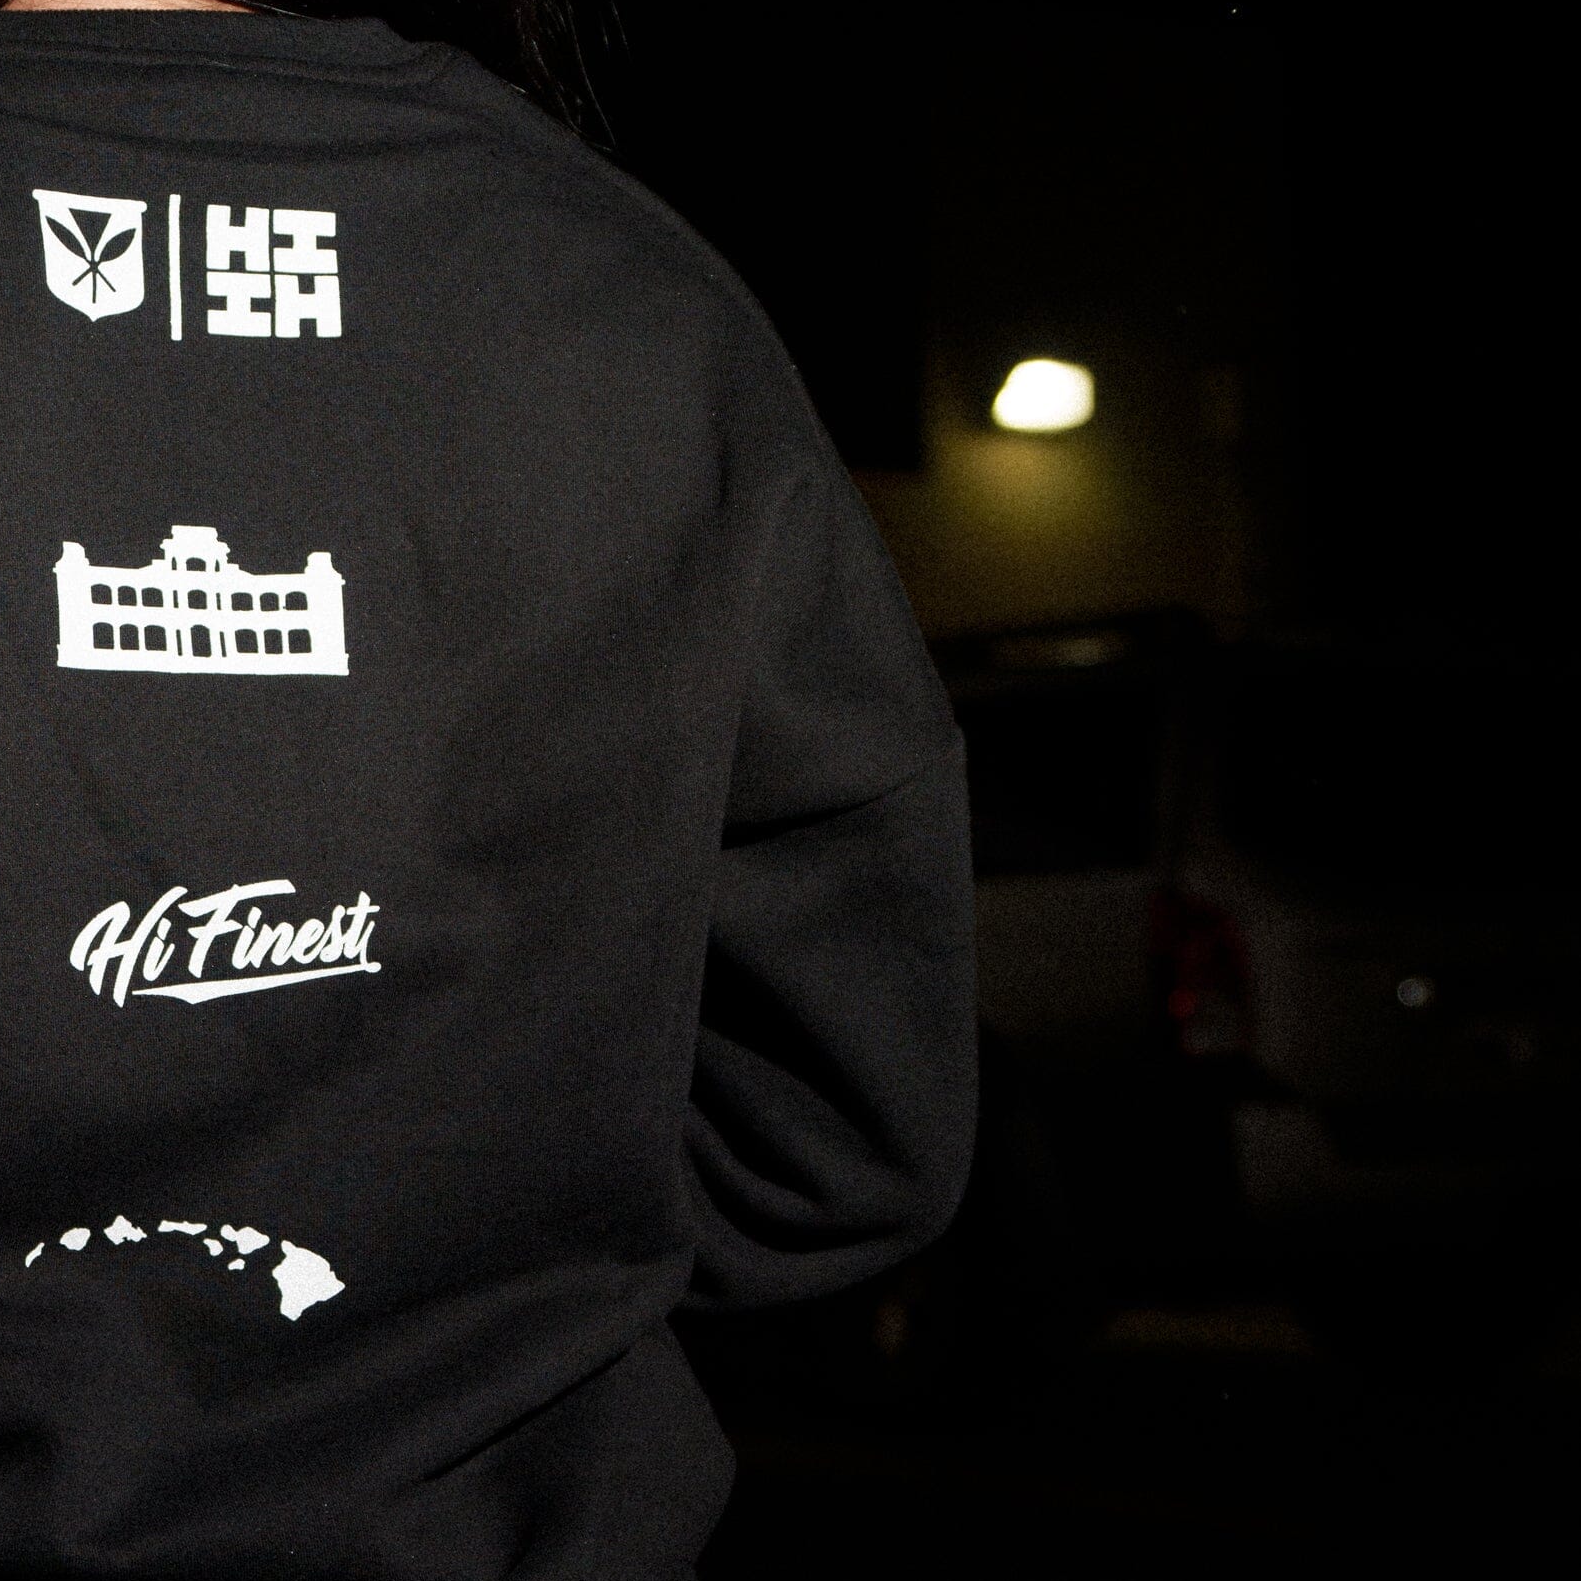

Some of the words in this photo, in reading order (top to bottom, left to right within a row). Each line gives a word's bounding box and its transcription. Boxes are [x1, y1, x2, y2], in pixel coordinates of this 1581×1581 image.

[205, 203, 339, 275] HI
[69, 885, 189, 1008] Hi
[177, 878, 381, 980] Finest
